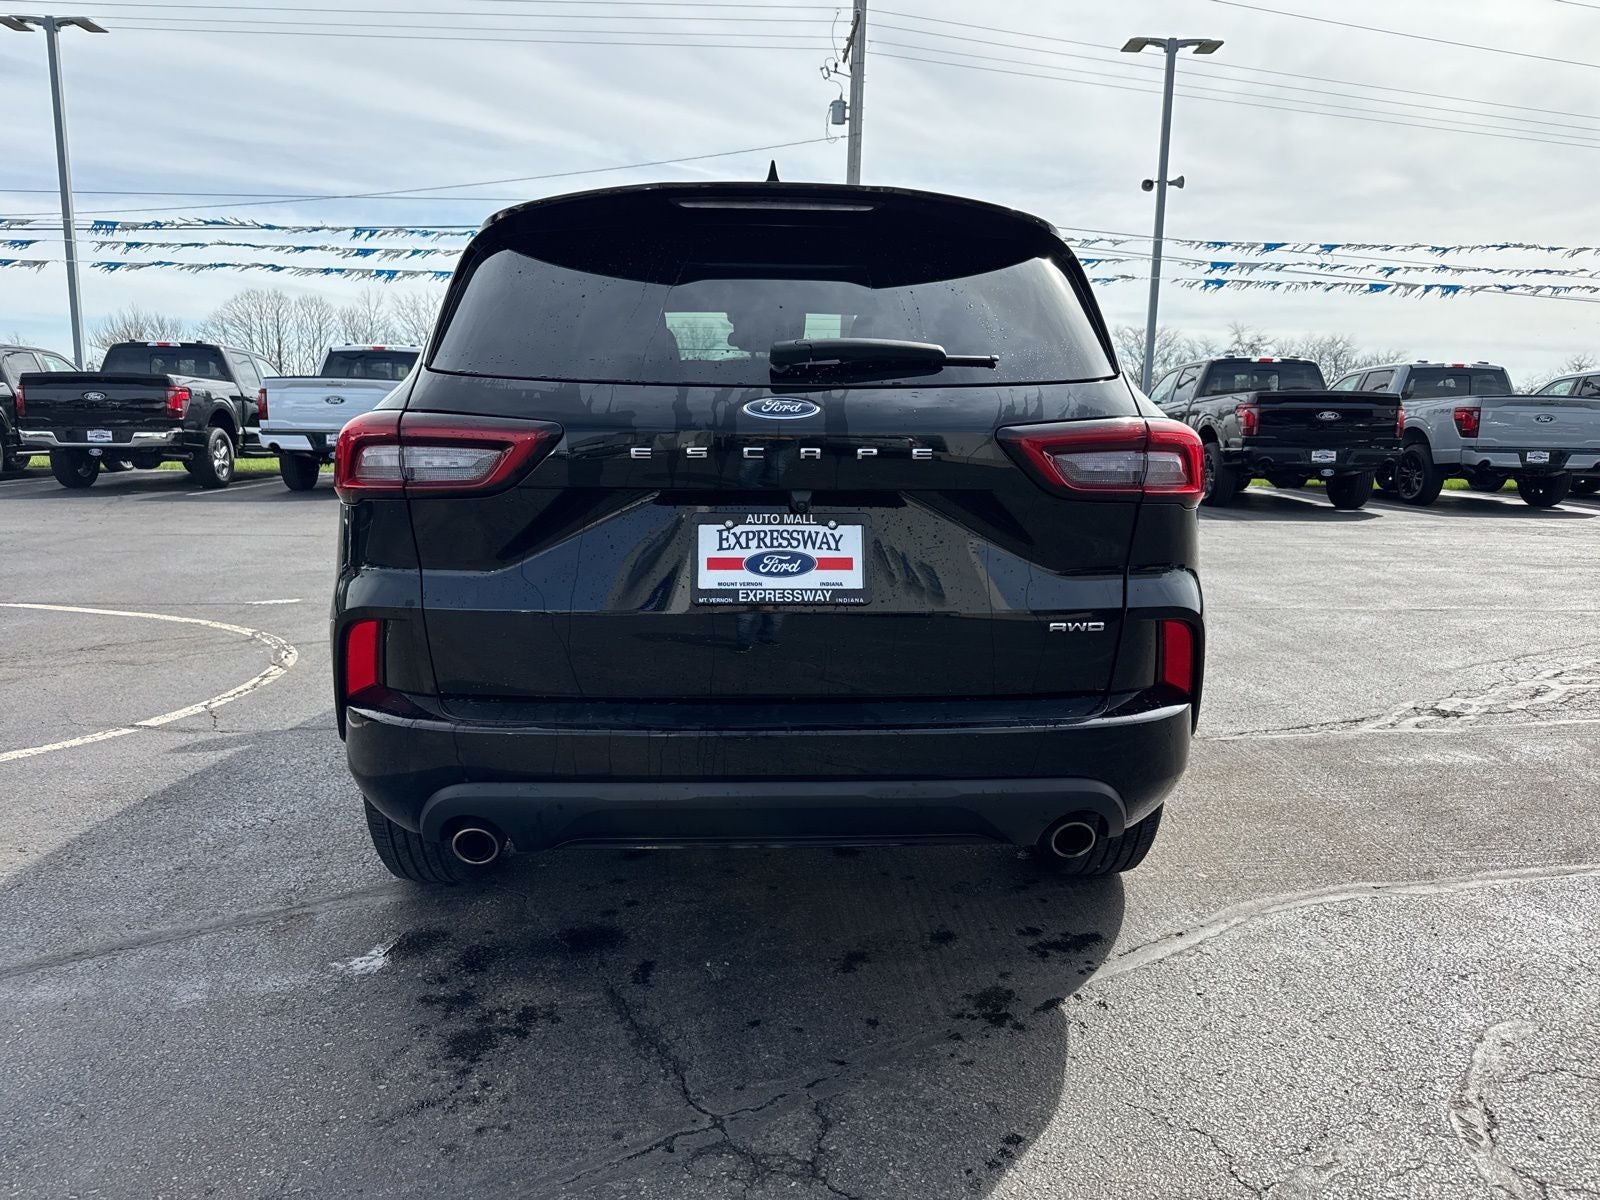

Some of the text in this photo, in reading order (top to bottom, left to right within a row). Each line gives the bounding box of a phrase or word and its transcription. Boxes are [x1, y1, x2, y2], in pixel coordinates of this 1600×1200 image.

[761, 400, 802, 412] Ford
[630, 447, 933, 460] ESCAPE
[745, 513, 817, 524] AUTO MALL
[716, 528, 844, 551] EXPRESSWAY
[759, 555, 801, 573] Ford
[738, 590, 832, 602] EXPRESSWAY
[1049, 621, 1105, 632] AWD
